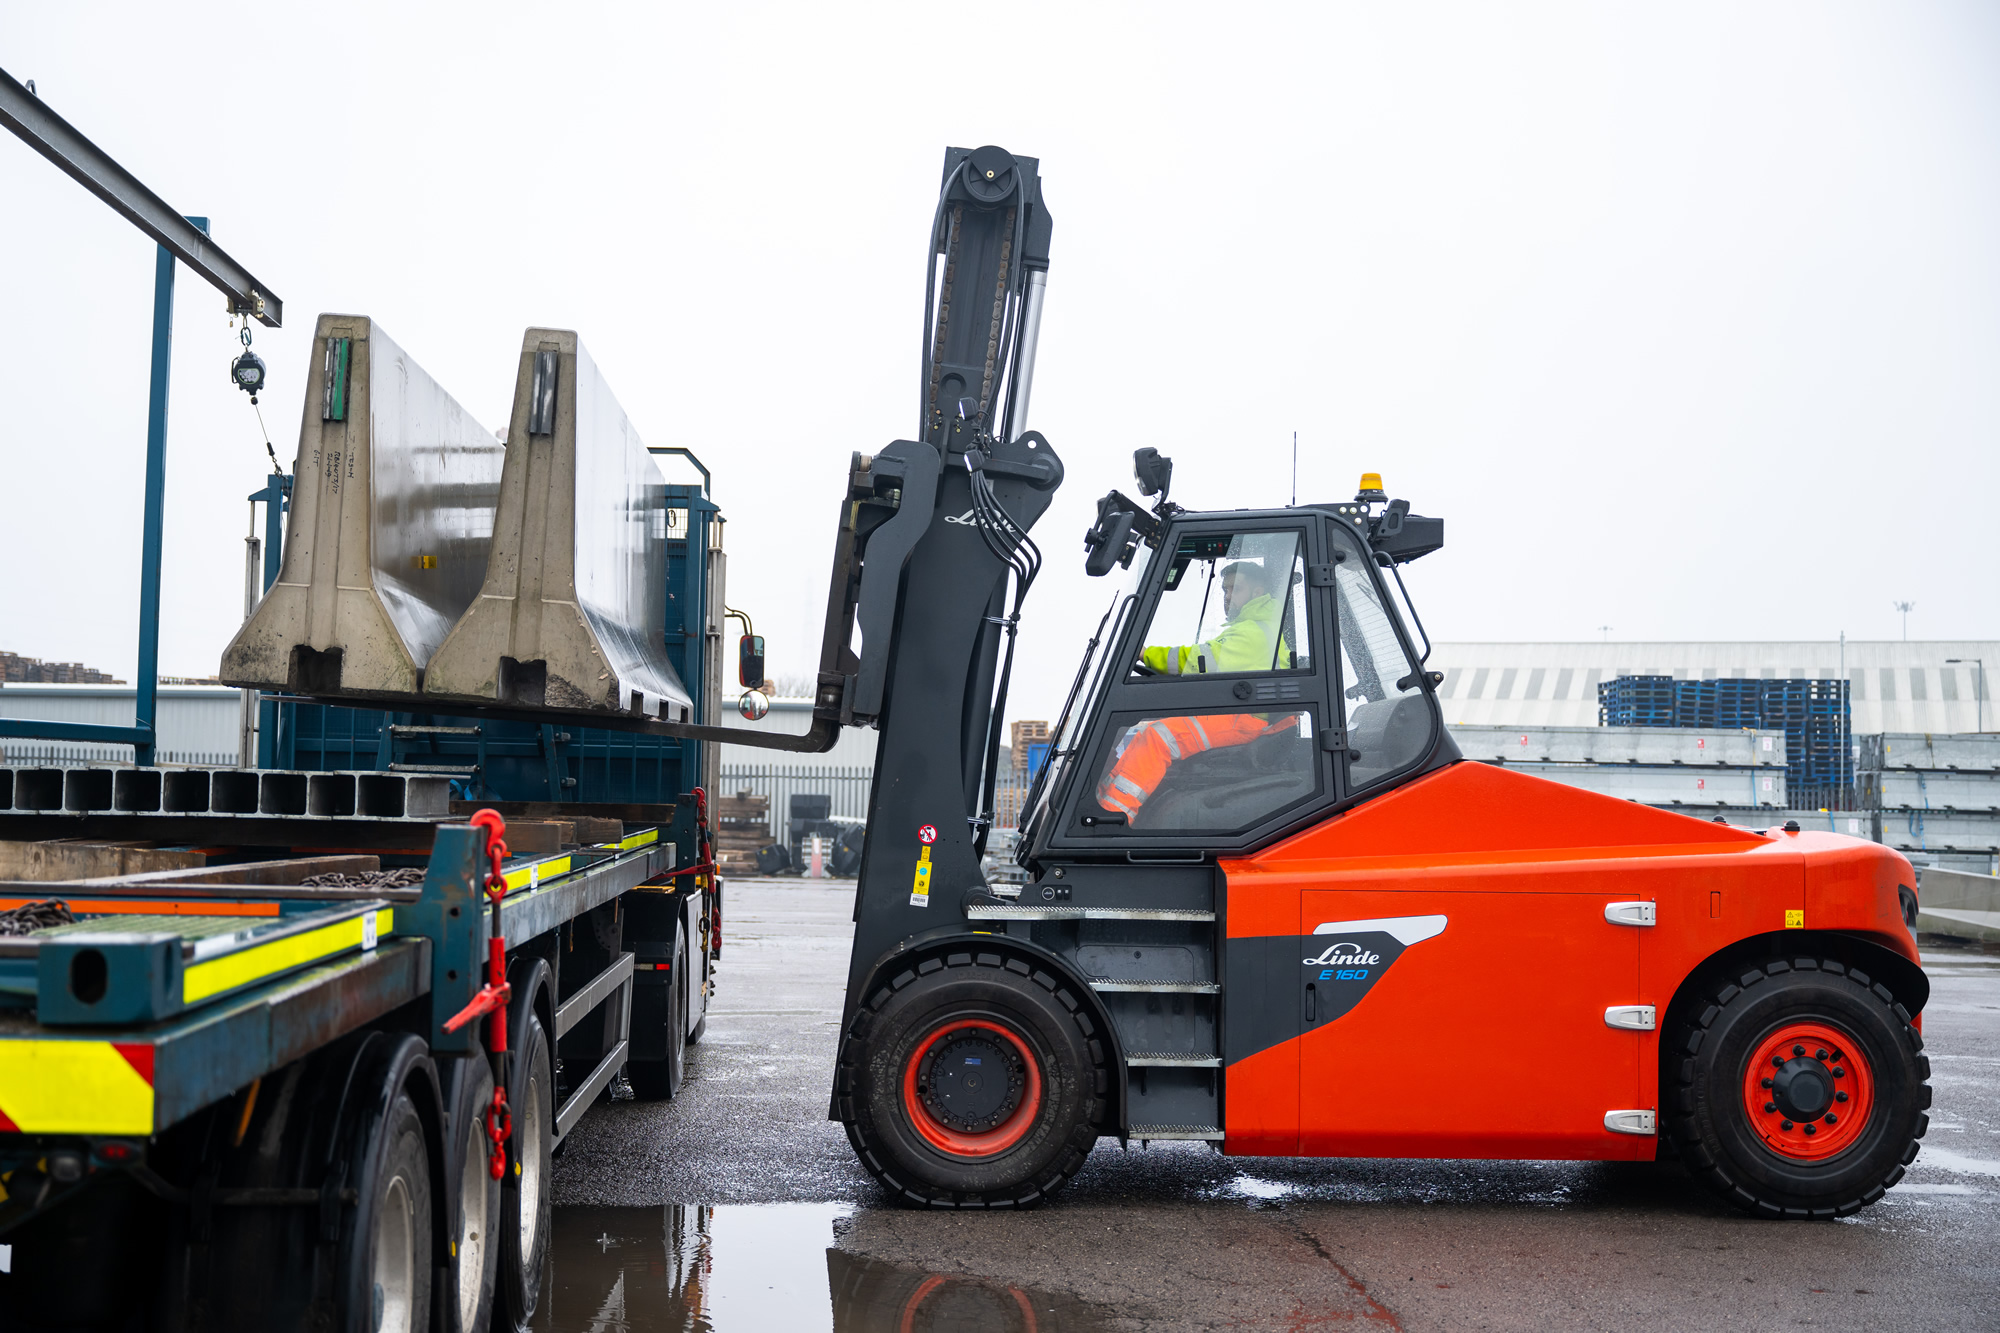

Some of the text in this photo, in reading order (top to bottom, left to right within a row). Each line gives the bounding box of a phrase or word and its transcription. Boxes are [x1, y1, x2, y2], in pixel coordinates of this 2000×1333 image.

[1302, 942, 1380, 966] Linde
[1318, 969, 1369, 980] E 160
